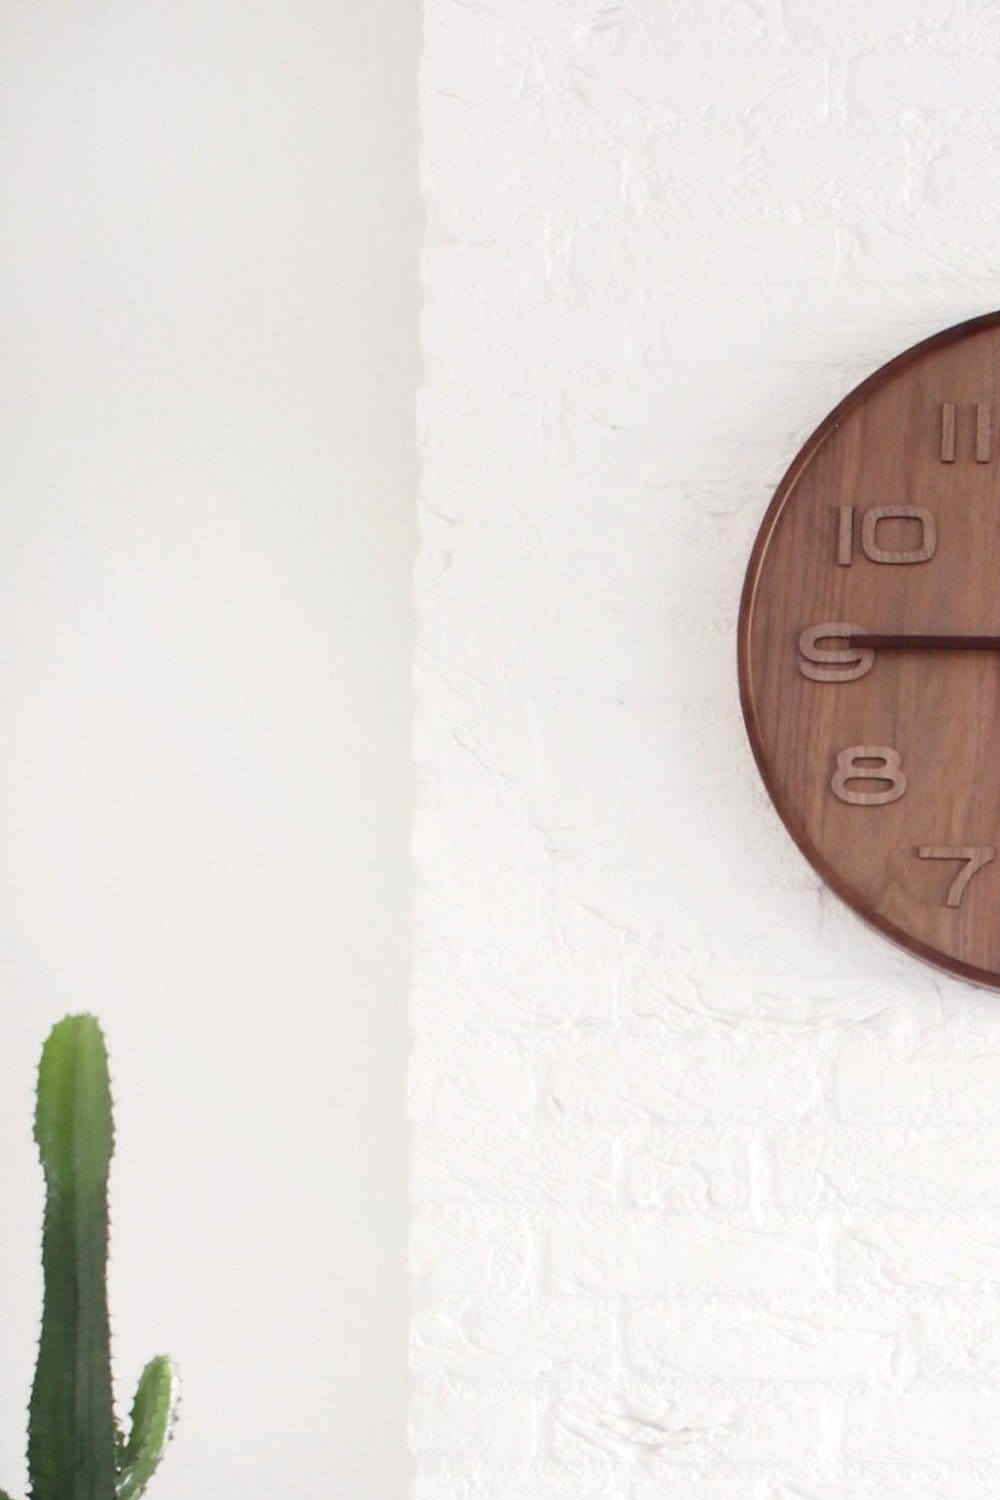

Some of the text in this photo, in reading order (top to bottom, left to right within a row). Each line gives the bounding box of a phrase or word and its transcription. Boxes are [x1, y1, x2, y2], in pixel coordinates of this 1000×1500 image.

[941, 402, 990, 463] 11
[838, 505, 937, 566] 10
[799, 621, 875, 682] 9
[831, 745, 907, 805] 8
[917, 846, 995, 907] 7
